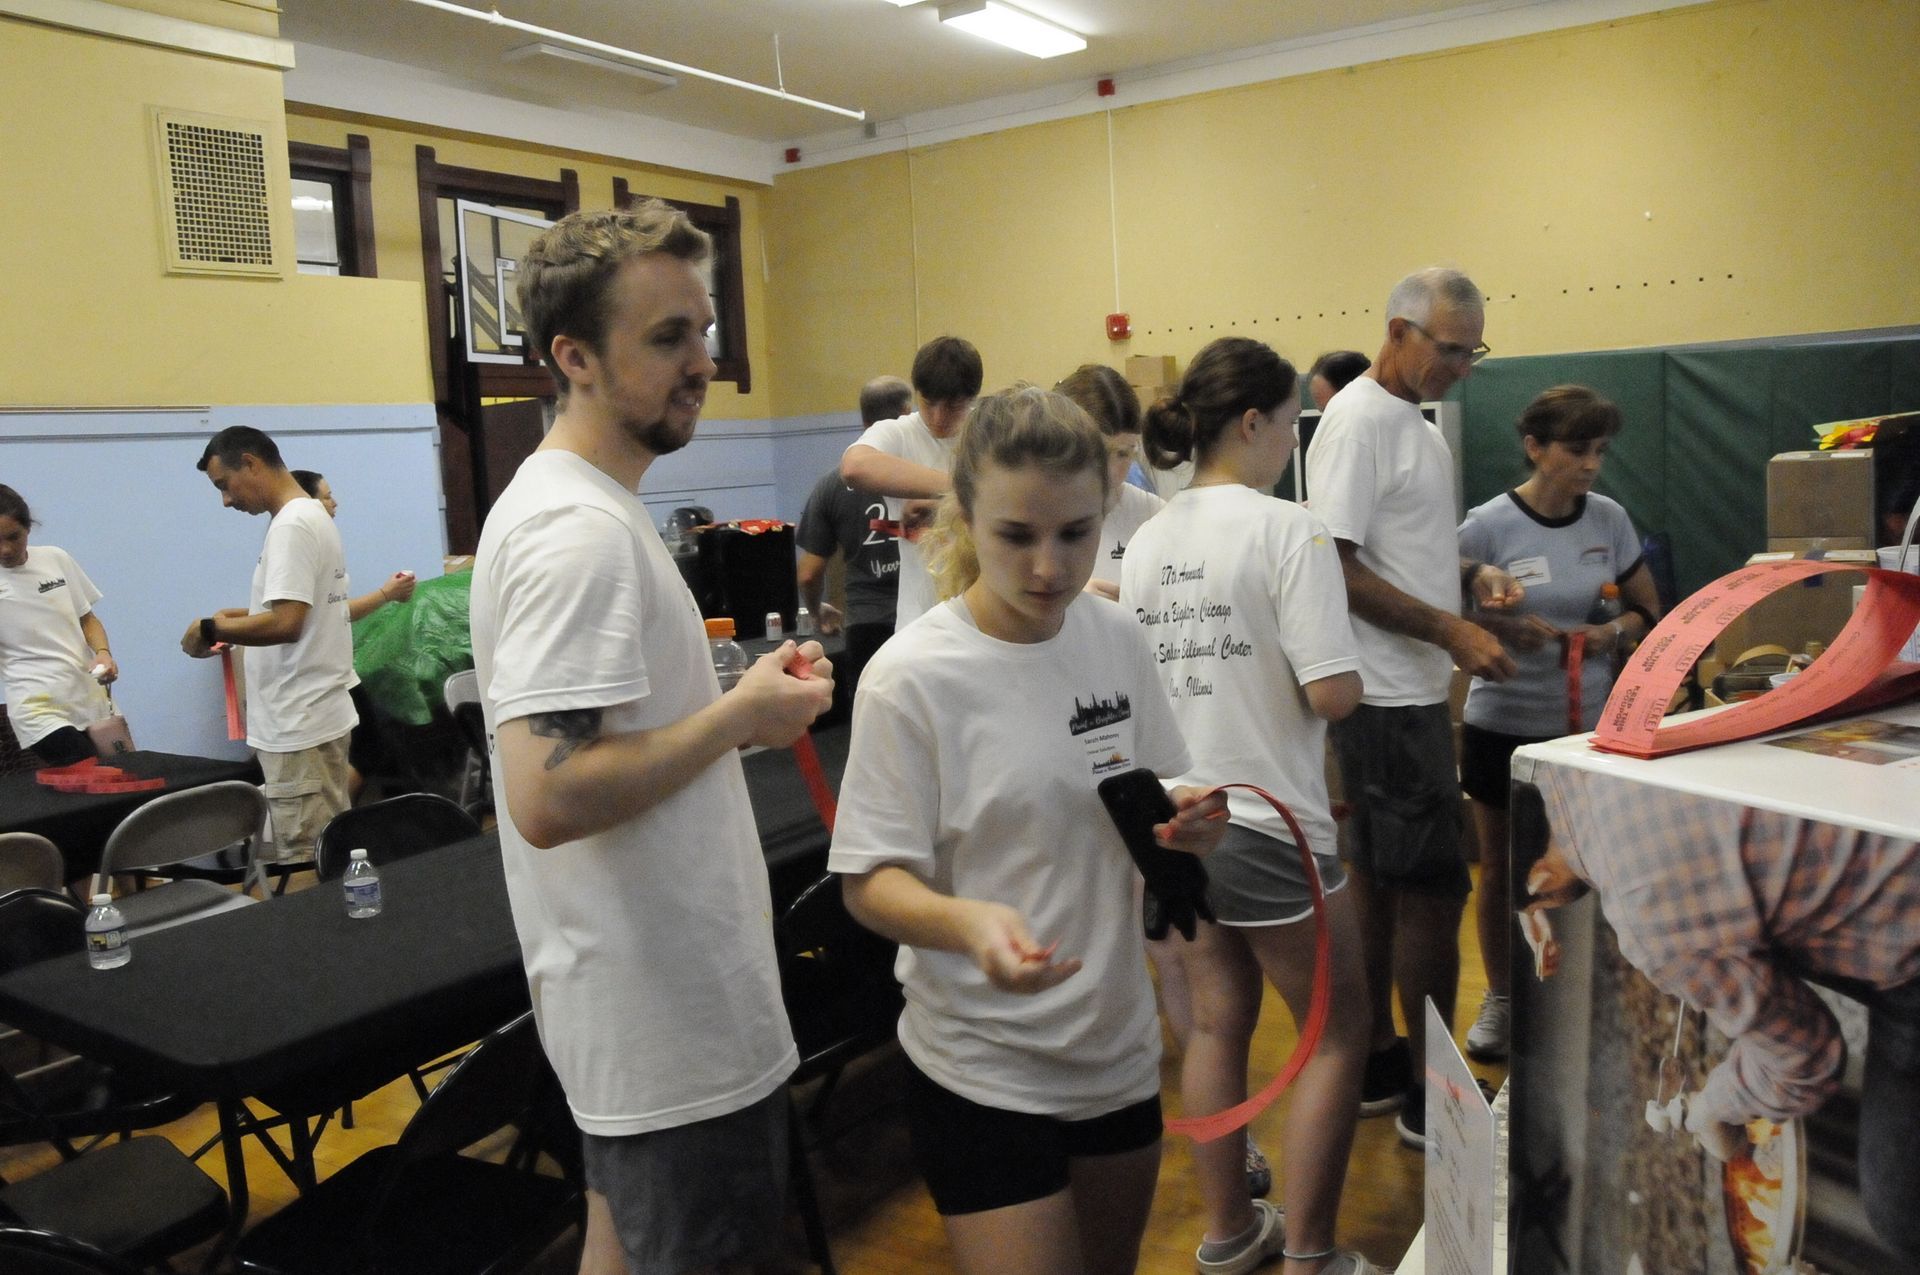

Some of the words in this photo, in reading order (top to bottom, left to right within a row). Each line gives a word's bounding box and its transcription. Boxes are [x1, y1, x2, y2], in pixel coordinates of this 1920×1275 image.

[1200, 597, 1232, 624] Chicago
[1221, 634, 1252, 660] Center
[1675, 643, 1705, 673] TICKET
[1186, 676, 1213, 697] Illinois
[1626, 685, 1641, 709] KEEP
[1613, 689, 1632, 726] COUPON
[1645, 697, 1667, 732] TICKET
[1616, 711, 1629, 732] THIS
